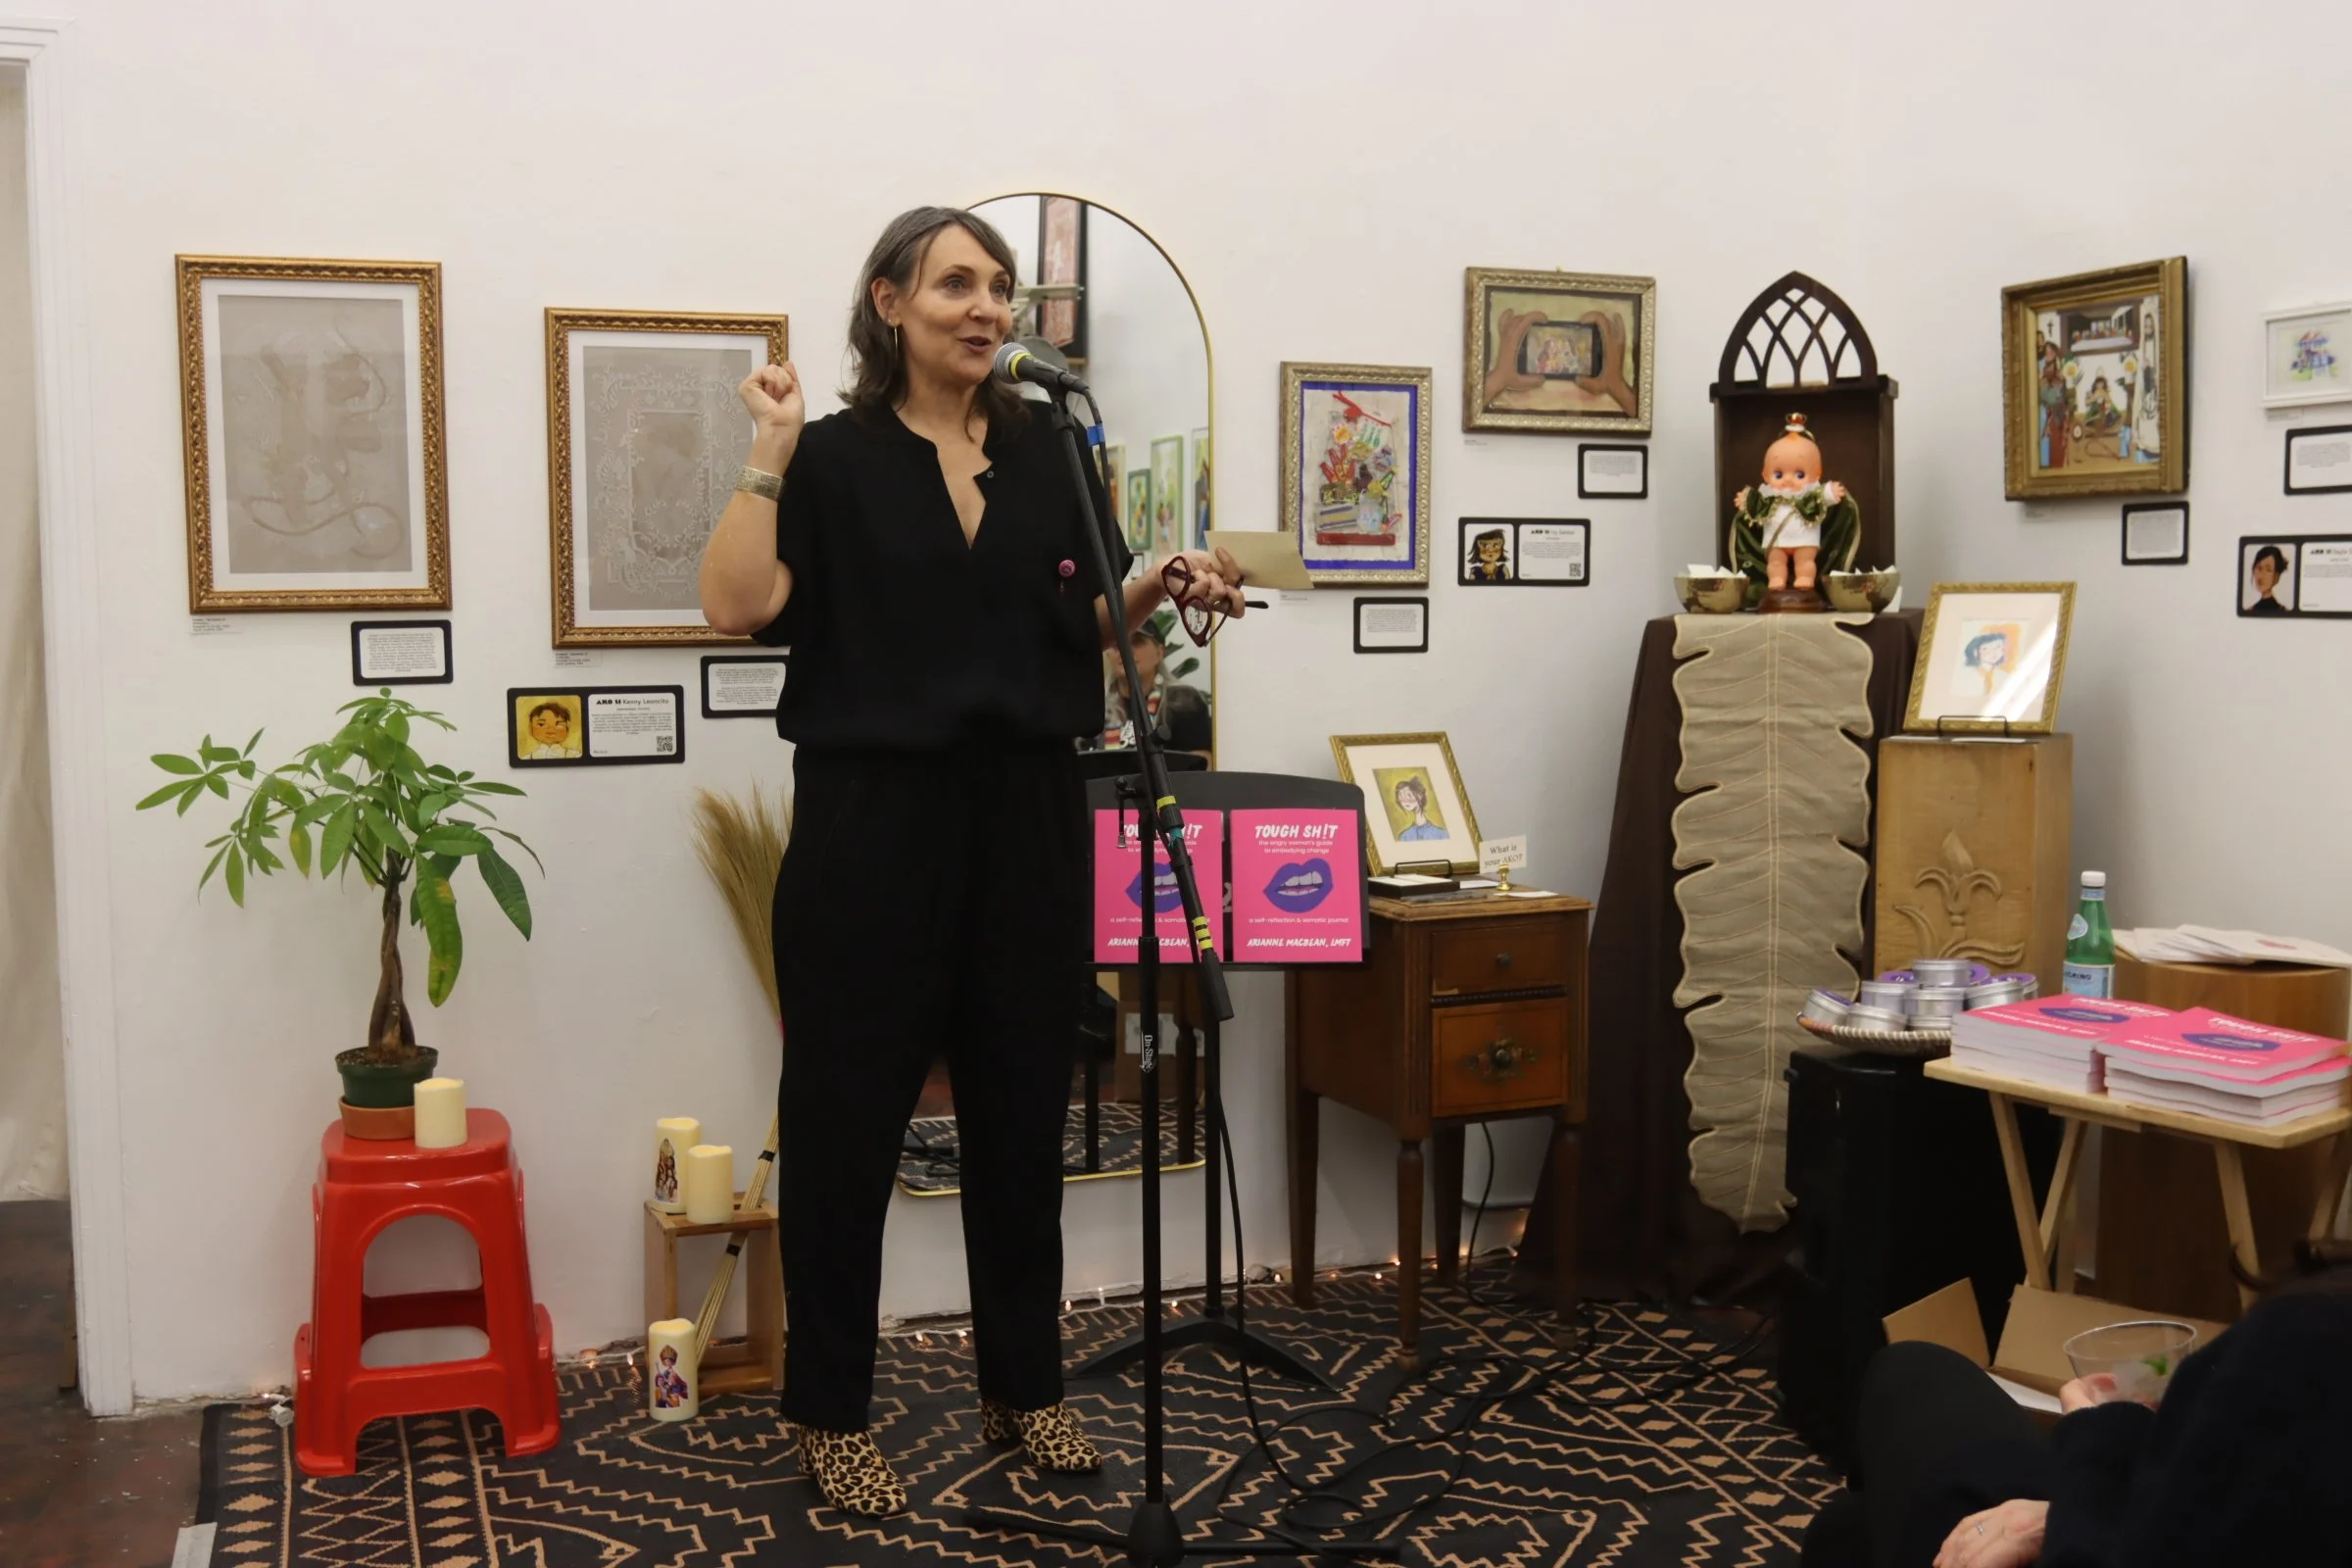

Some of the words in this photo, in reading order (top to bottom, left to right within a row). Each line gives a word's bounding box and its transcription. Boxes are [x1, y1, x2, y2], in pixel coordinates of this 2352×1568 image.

[1254, 824, 1299, 839] TOUGH
[1302, 823, 1339, 840] SH!T
[1490, 845, 1509, 855] What
[1484, 858, 1500, 868] your
[1107, 938, 1139, 947] ARIANN
[1158, 938, 1190, 948] CBEAN,
[1247, 938, 1284, 947] ARIANNE
[1286, 938, 1329, 948] MACBEAN,
[1331, 938, 1352, 947] LMFT
